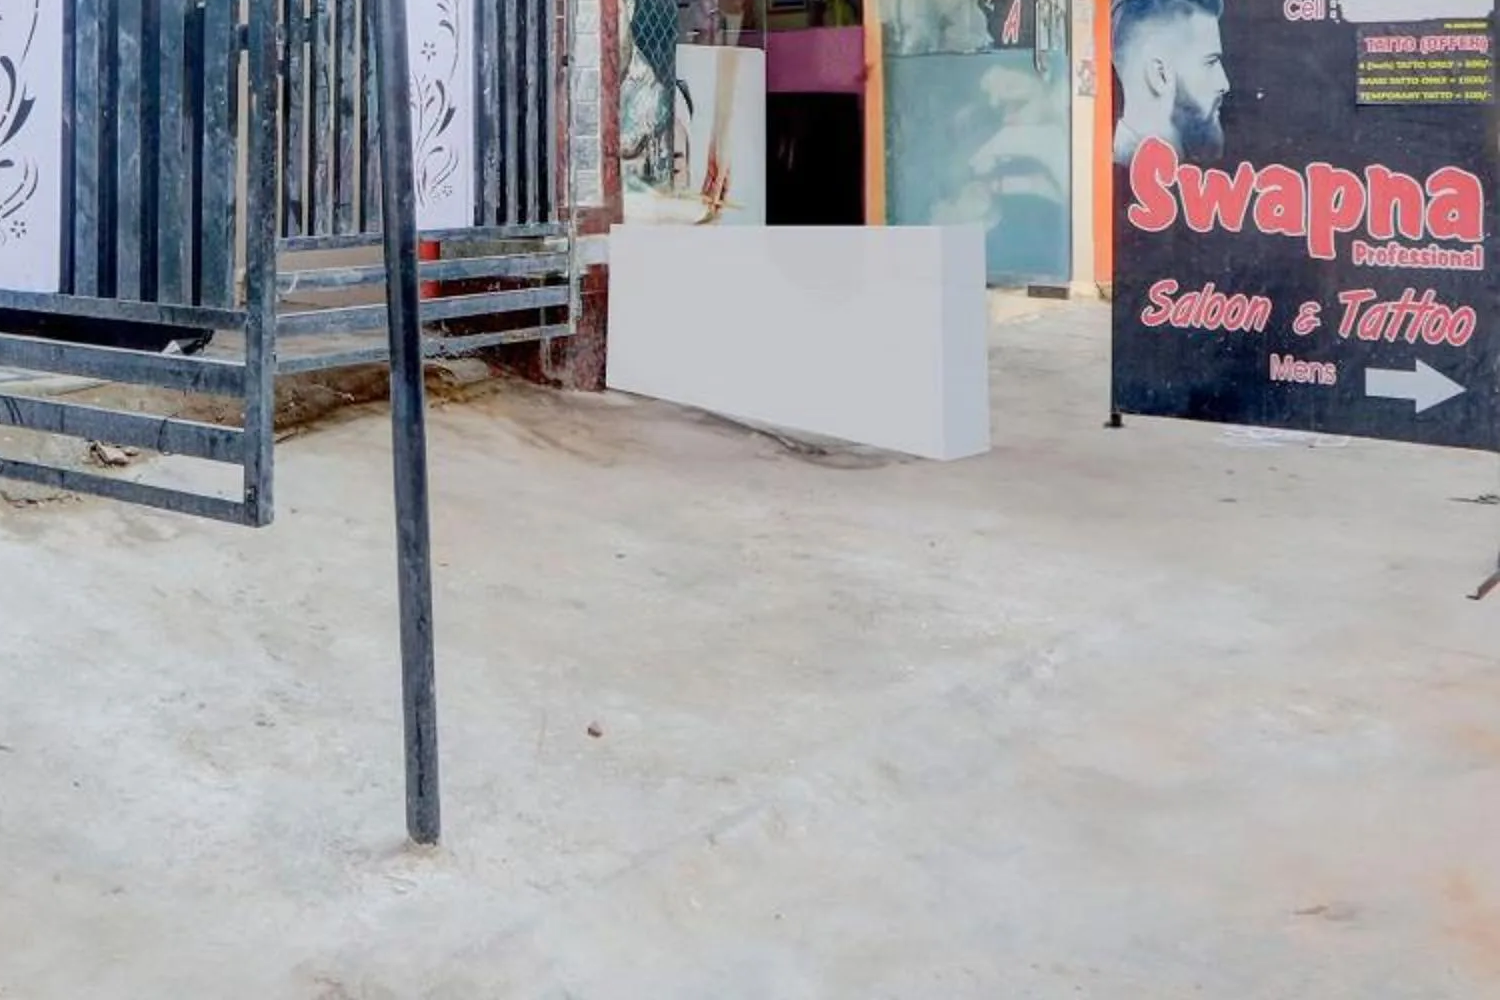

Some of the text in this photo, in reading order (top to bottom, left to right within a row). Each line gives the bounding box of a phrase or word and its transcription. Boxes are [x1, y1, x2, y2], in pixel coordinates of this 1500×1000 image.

[1127, 136, 1484, 260] Swapna
[1352, 240, 1484, 270] Professional
[1141, 279, 1476, 347] Saloon & Tattoo
[1269, 353, 1337, 384] Mens
